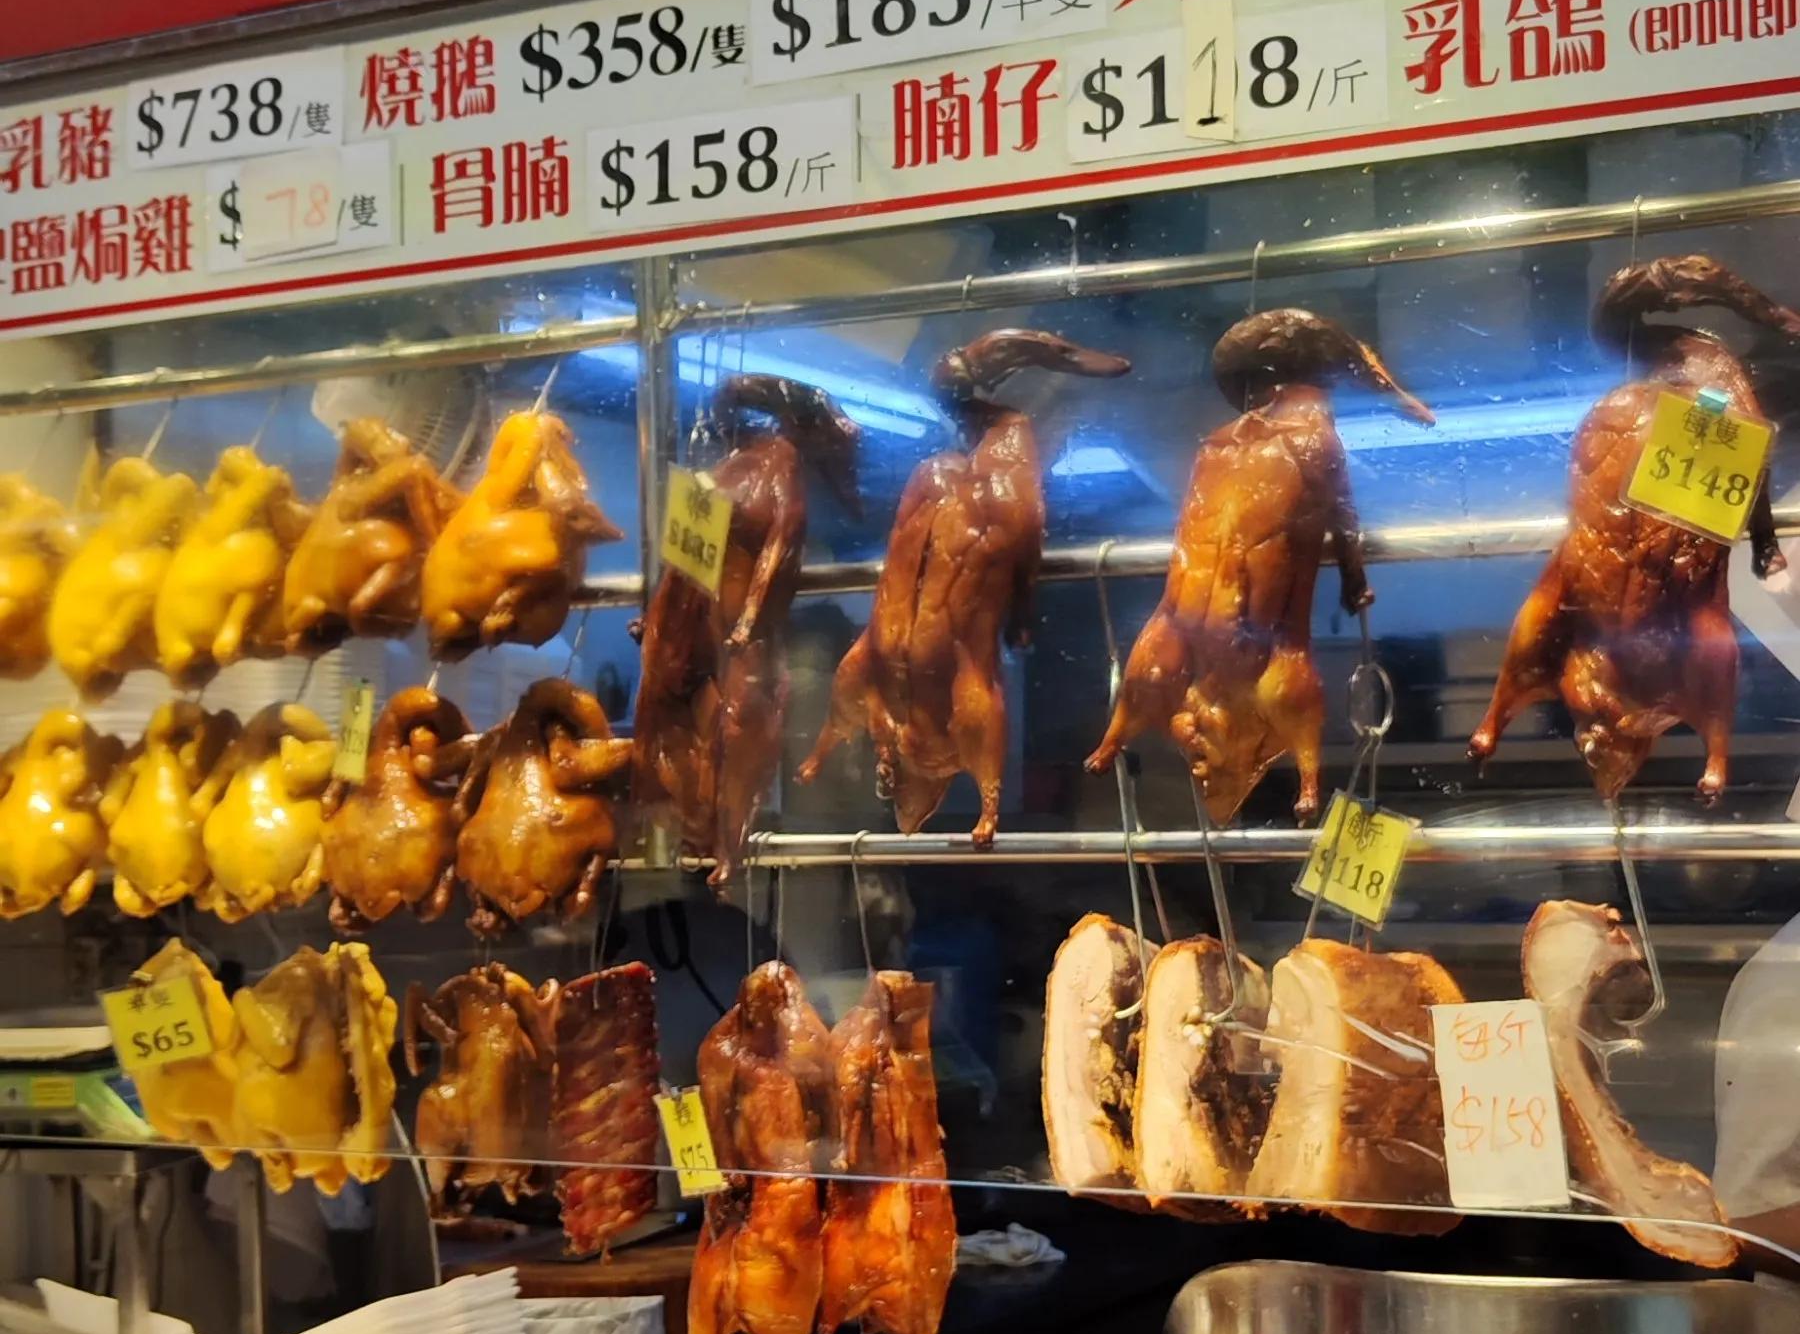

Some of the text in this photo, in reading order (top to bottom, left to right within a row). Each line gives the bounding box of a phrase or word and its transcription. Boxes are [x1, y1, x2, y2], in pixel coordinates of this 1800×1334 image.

[137, 77, 332, 159] $738/隻
[360, 33, 496, 133] 燒鵝
[519, 4, 747, 102] $358/隻
[0, 193, 195, 295] 鹽焗雞
[429, 135, 570, 234] 骨腩
[600, 125, 836, 216] $158/斤
[890, 58, 1060, 170] 腩仔
[1649, 444, 1750, 507] $148
[1314, 848, 1385, 900] $118
[131, 1020, 195, 1058] $65
[1450, 1084, 1547, 1155] $158
